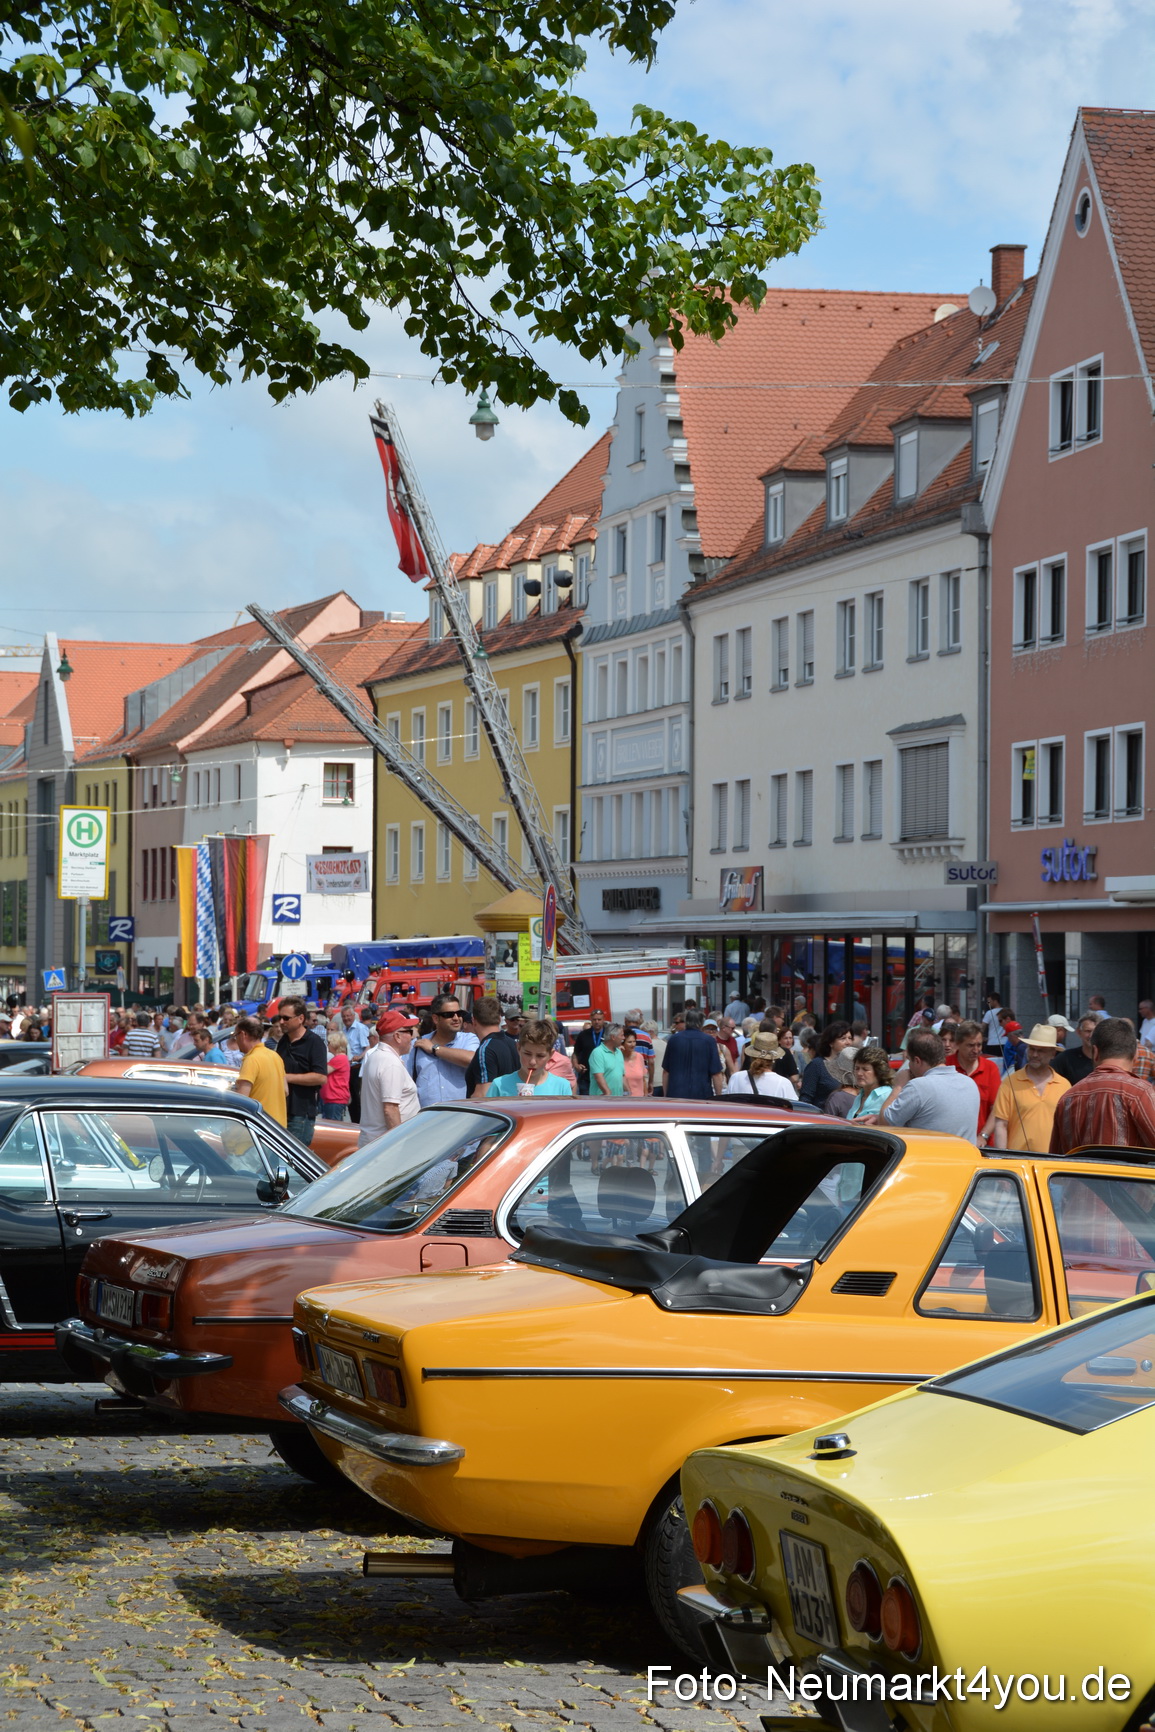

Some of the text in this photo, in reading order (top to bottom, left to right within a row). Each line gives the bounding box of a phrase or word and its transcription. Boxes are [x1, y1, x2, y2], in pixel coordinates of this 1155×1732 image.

[76, 821, 93, 840] H
[948, 865, 997, 880] sutor.
[793, 1543, 817, 1592] AM
